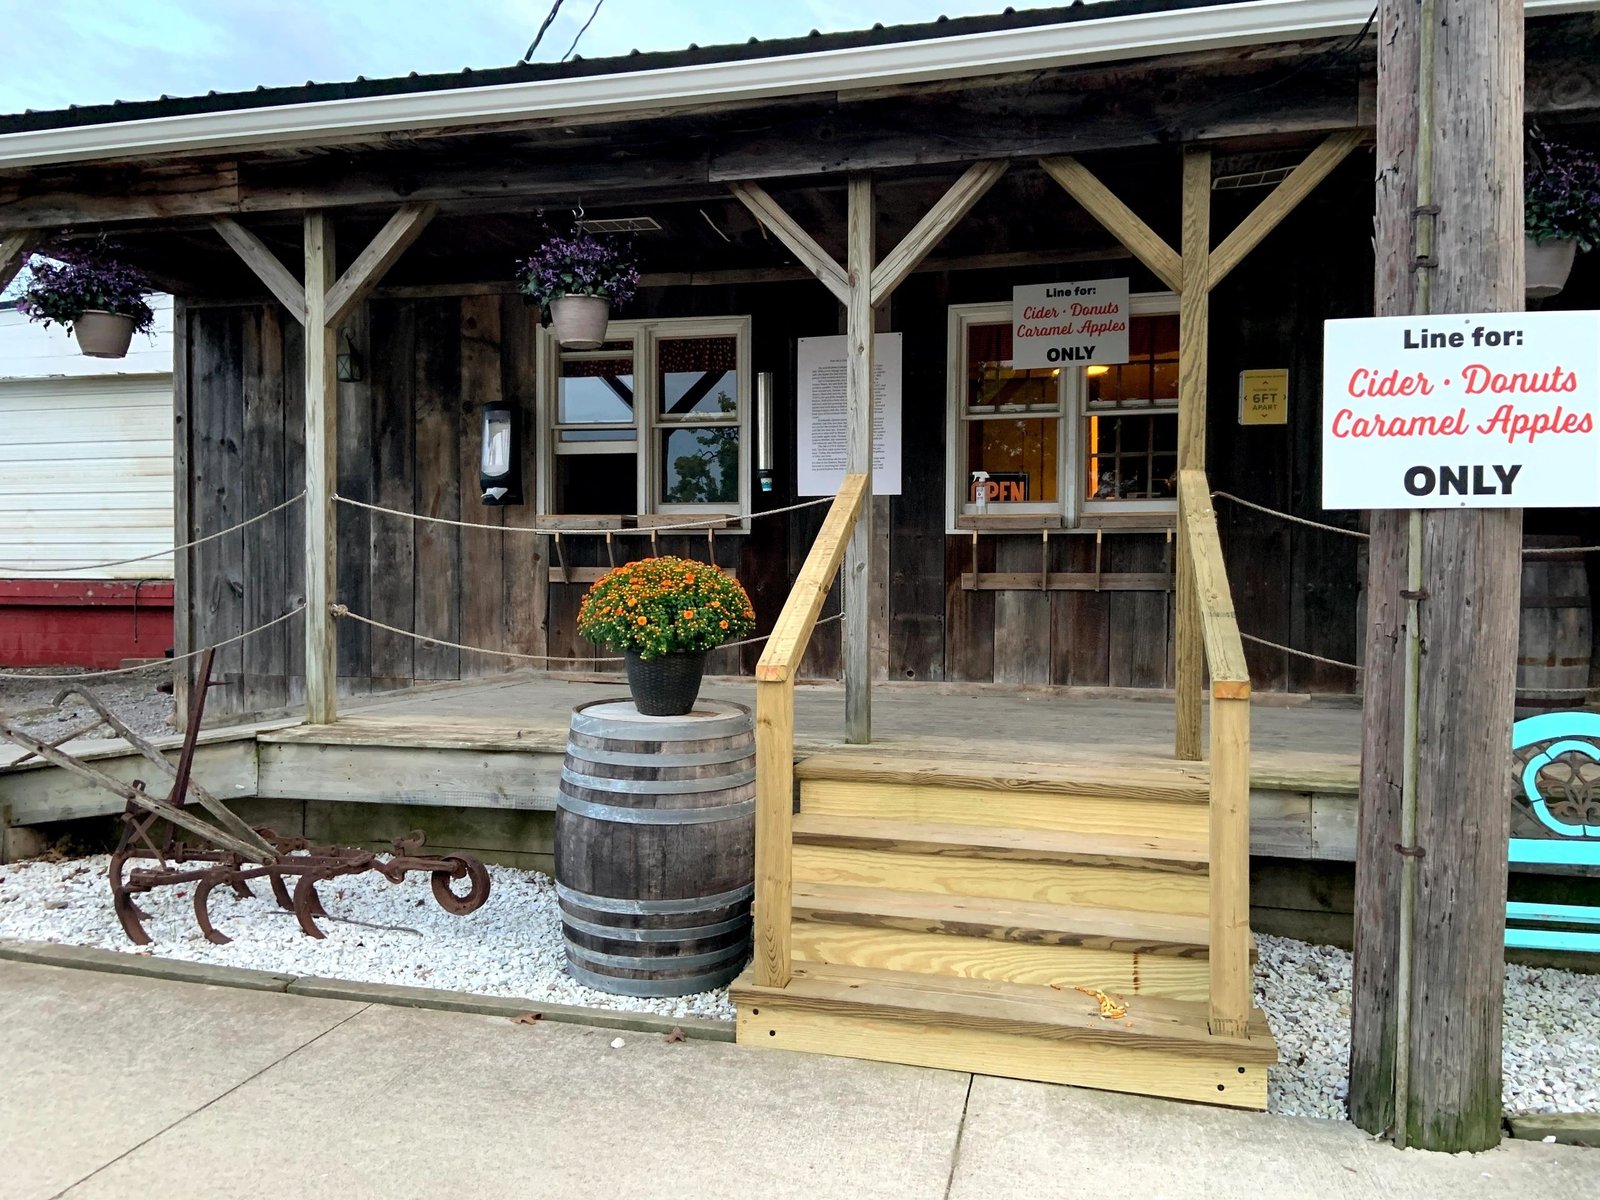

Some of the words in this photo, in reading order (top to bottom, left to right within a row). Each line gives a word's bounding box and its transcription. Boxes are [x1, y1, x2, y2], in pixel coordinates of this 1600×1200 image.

[1046, 288, 1072, 298] Line
[1074, 286, 1096, 296] for:
[1023, 306, 1060, 320] Cider
[1070, 302, 1119, 317] Donuts
[1016, 322, 1073, 338] Caramel
[1076, 319, 1126, 337] Apples
[1403, 329, 1464, 349] Line
[1471, 326, 1523, 347] for:
[1046, 345, 1096, 362] ONLY
[1348, 368, 1434, 398] Cider
[1461, 364, 1578, 394] Donuts
[1252, 393, 1278, 404] 6FT
[1331, 408, 1469, 438] Caramel
[1476, 404, 1593, 444] Apples
[1403, 464, 1523, 496] ONLY
